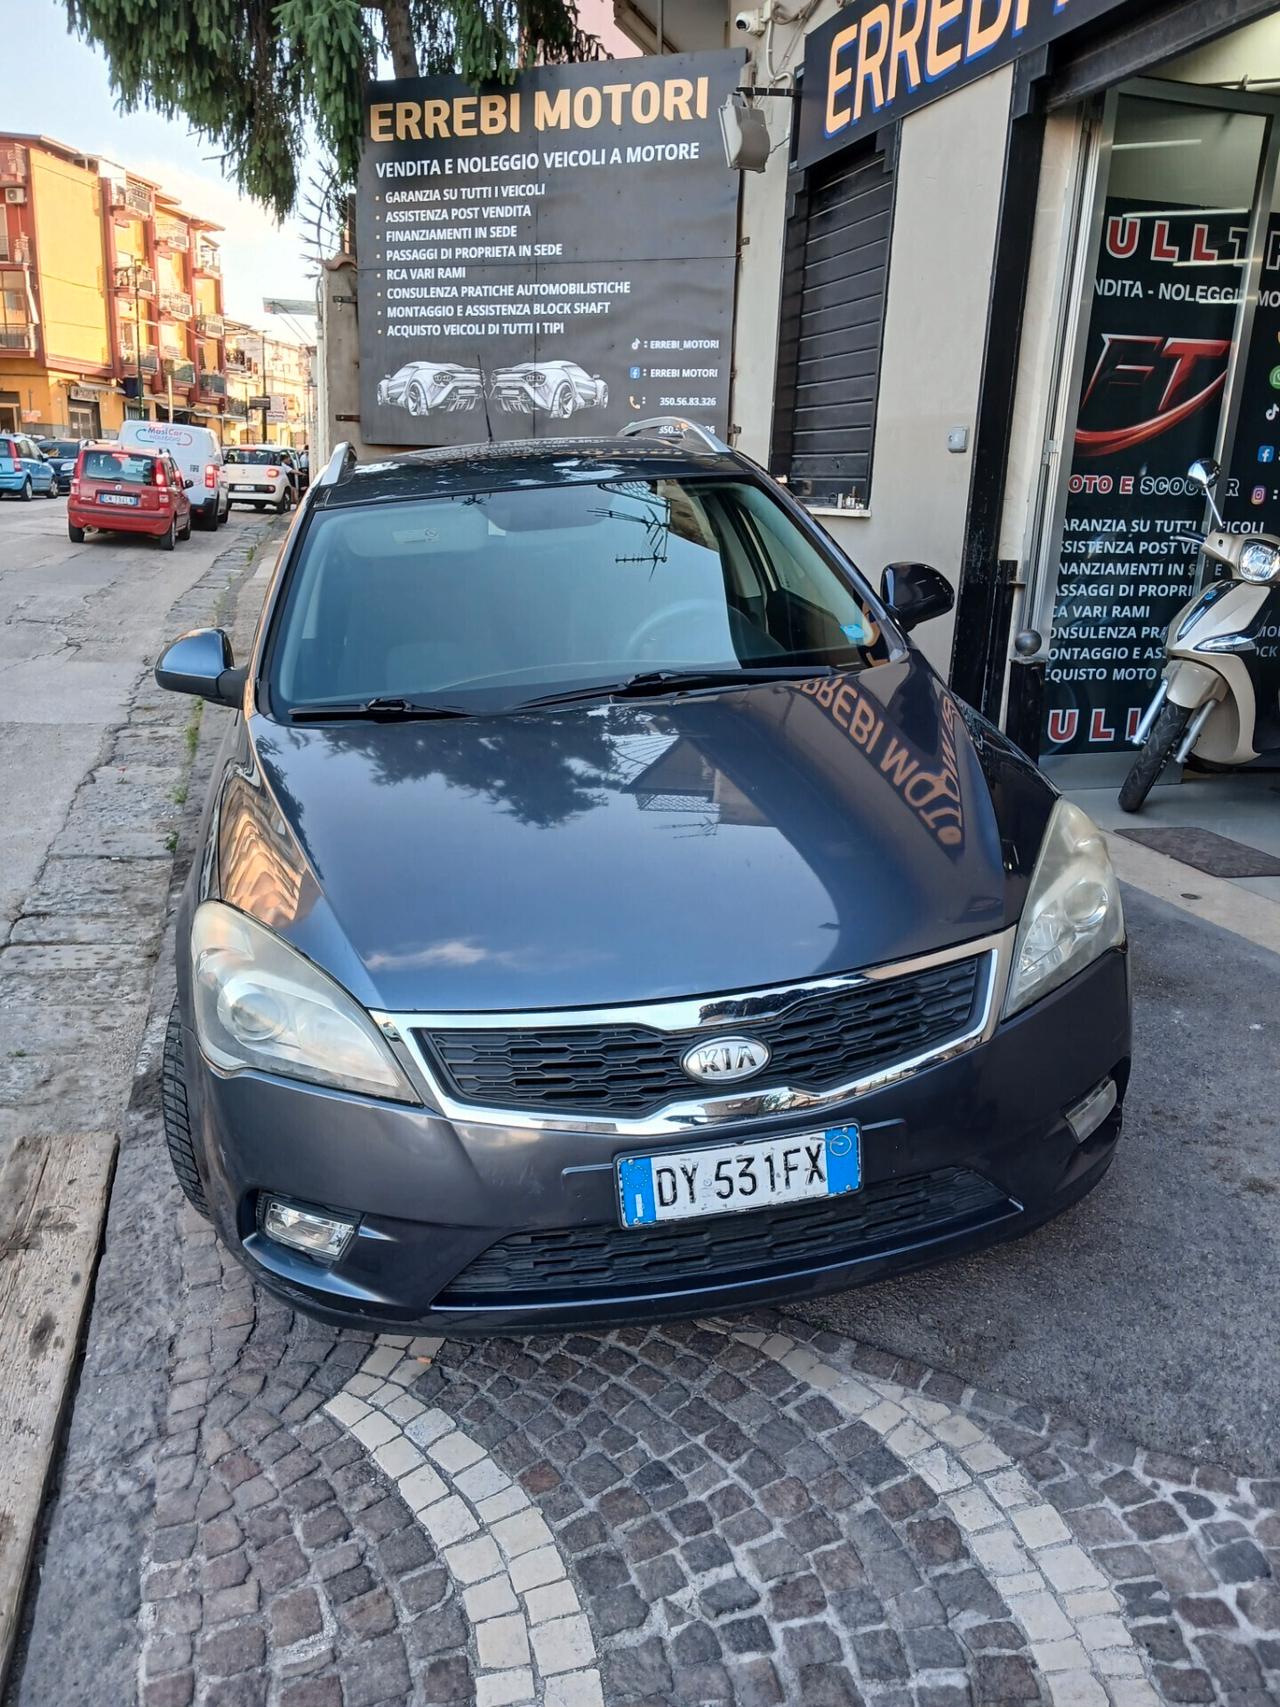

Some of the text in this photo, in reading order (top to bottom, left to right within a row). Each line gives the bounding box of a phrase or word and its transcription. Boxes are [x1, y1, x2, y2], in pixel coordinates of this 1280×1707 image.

[825, 0, 1029, 135] ERRE
[370, 76, 709, 142] ERREBI MOTORI
[375, 142, 699, 178] VENDITA E NOLEGGIO VEICOLI A MOTORE
[385, 183, 546, 203] GARANZIA SU TUTTI I VEICOLI
[385, 205, 531, 223] ASSISTENZA POST VENDITA
[386, 225, 517, 242] FINANZIAMENTI IN SEDE
[386, 244, 563, 261] PASSAGGI DI PROPRIETA IN SEDE
[387, 267, 466, 280] RCA VARI RAMI
[387, 282, 631, 300] CONSULENZA PRATICHE AUTOMOBILISTICHE
[1159, 283, 1242, 304] NOLEGGI
[387, 302, 611, 318] MONTAGGIO E ASSISTENZA BLOCK SHAFT
[387, 322, 564, 338] ACQUISTO VEICOLI DI TUTTI I TIPI
[650, 340, 719, 350] ERREBI_MOTORI
[650, 369, 680, 378] ERREBI
[682, 368, 718, 378] MOTORI
[1120, 476, 1134, 494] E
[1131, 520, 1150, 532] SU
[1155, 520, 1197, 533] TUTTI
[1139, 541, 1177, 554] POST
[1167, 563, 1184, 575] IN
[1119, 584, 1134, 597] DI
[1073, 606, 1107, 618] VARI
[1112, 606, 1150, 618] RAMI
[1133, 648, 1141, 659] E
[1112, 668, 1156, 680] MOTO
[697, 1045, 756, 1073] KIA
[656, 1163, 698, 1207] DY
[714, 1144, 827, 1199] 531FX
